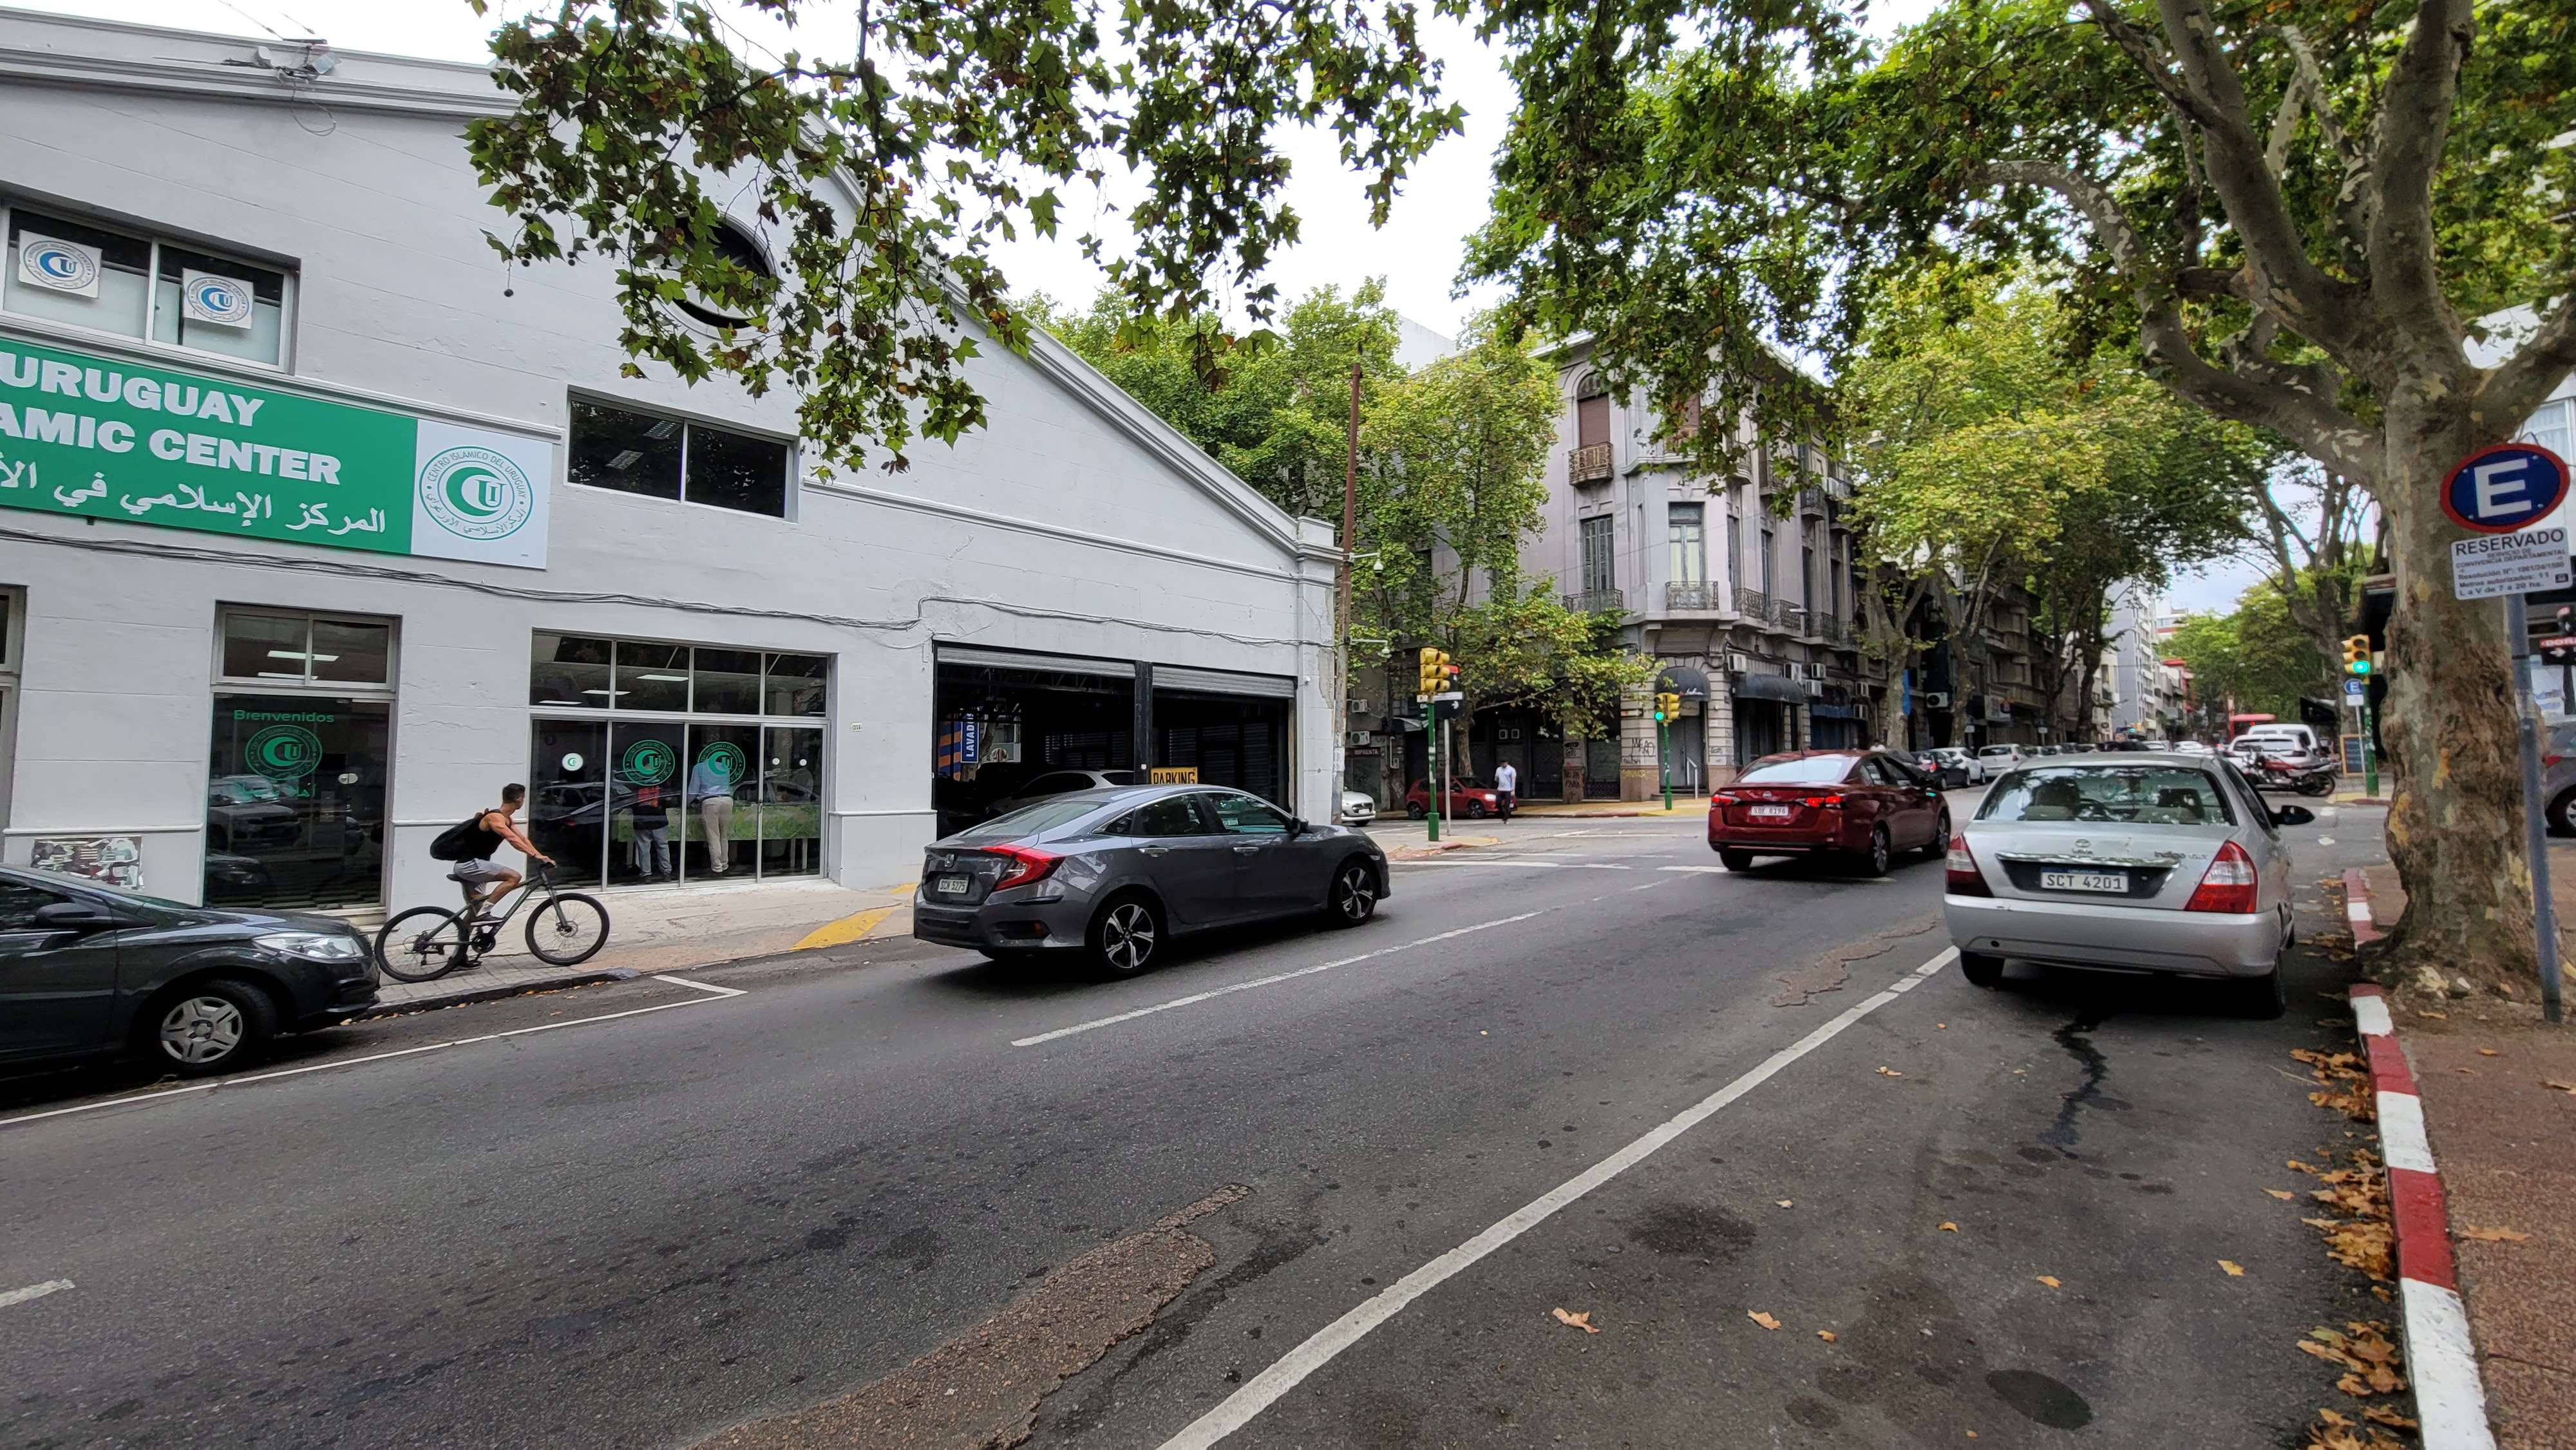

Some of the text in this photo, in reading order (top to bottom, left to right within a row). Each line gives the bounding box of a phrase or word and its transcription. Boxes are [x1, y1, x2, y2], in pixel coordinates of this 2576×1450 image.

[0, 352, 265, 426] URUGUAY
[149, 429, 341, 485] CENTER
[53, 472, 107, 507] في
[428, 451, 527, 498] CENTRO ISLAMICO DEL URUGUAY
[2474, 458, 2532, 518] E
[120, 484, 272, 527] الإسلامي
[285, 503, 385, 535] المركز
[2456, 529, 2564, 556] RESERVADO
[2504, 549, 2566, 562] DEPARTAMENTAL
[2351, 681, 2360, 692] E
[234, 710, 334, 722] Bienvenidos
[1153, 772, 1195, 784] PARKING
[2047, 874, 2123, 890] SCT 4201
